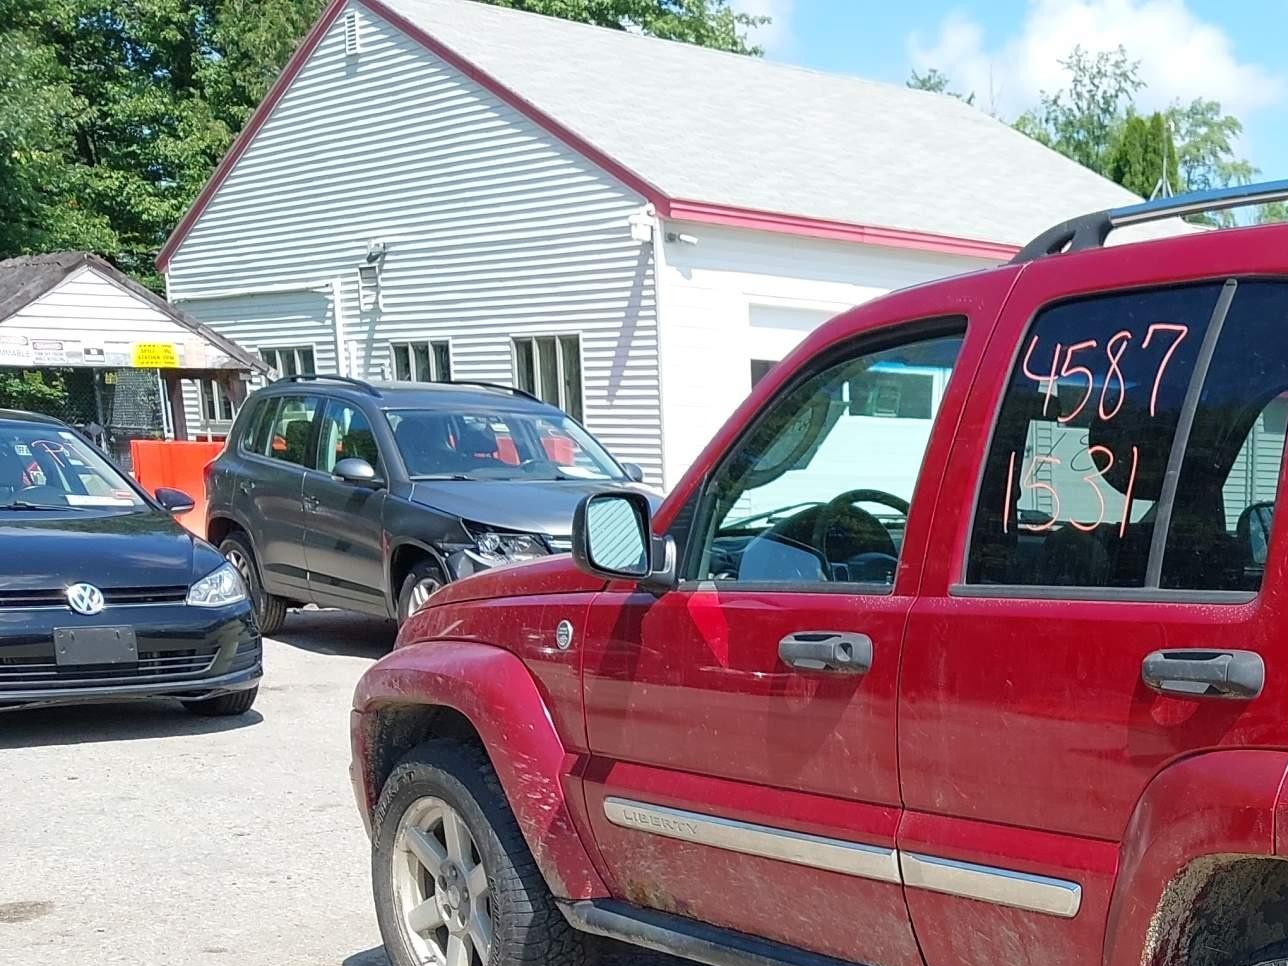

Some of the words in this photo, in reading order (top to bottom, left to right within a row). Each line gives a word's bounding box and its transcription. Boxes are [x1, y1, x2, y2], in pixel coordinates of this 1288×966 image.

[1022, 323, 1189, 423] 4587
[1003, 445, 1138, 539] 1531
[622, 808, 699, 836] LIBERTY
